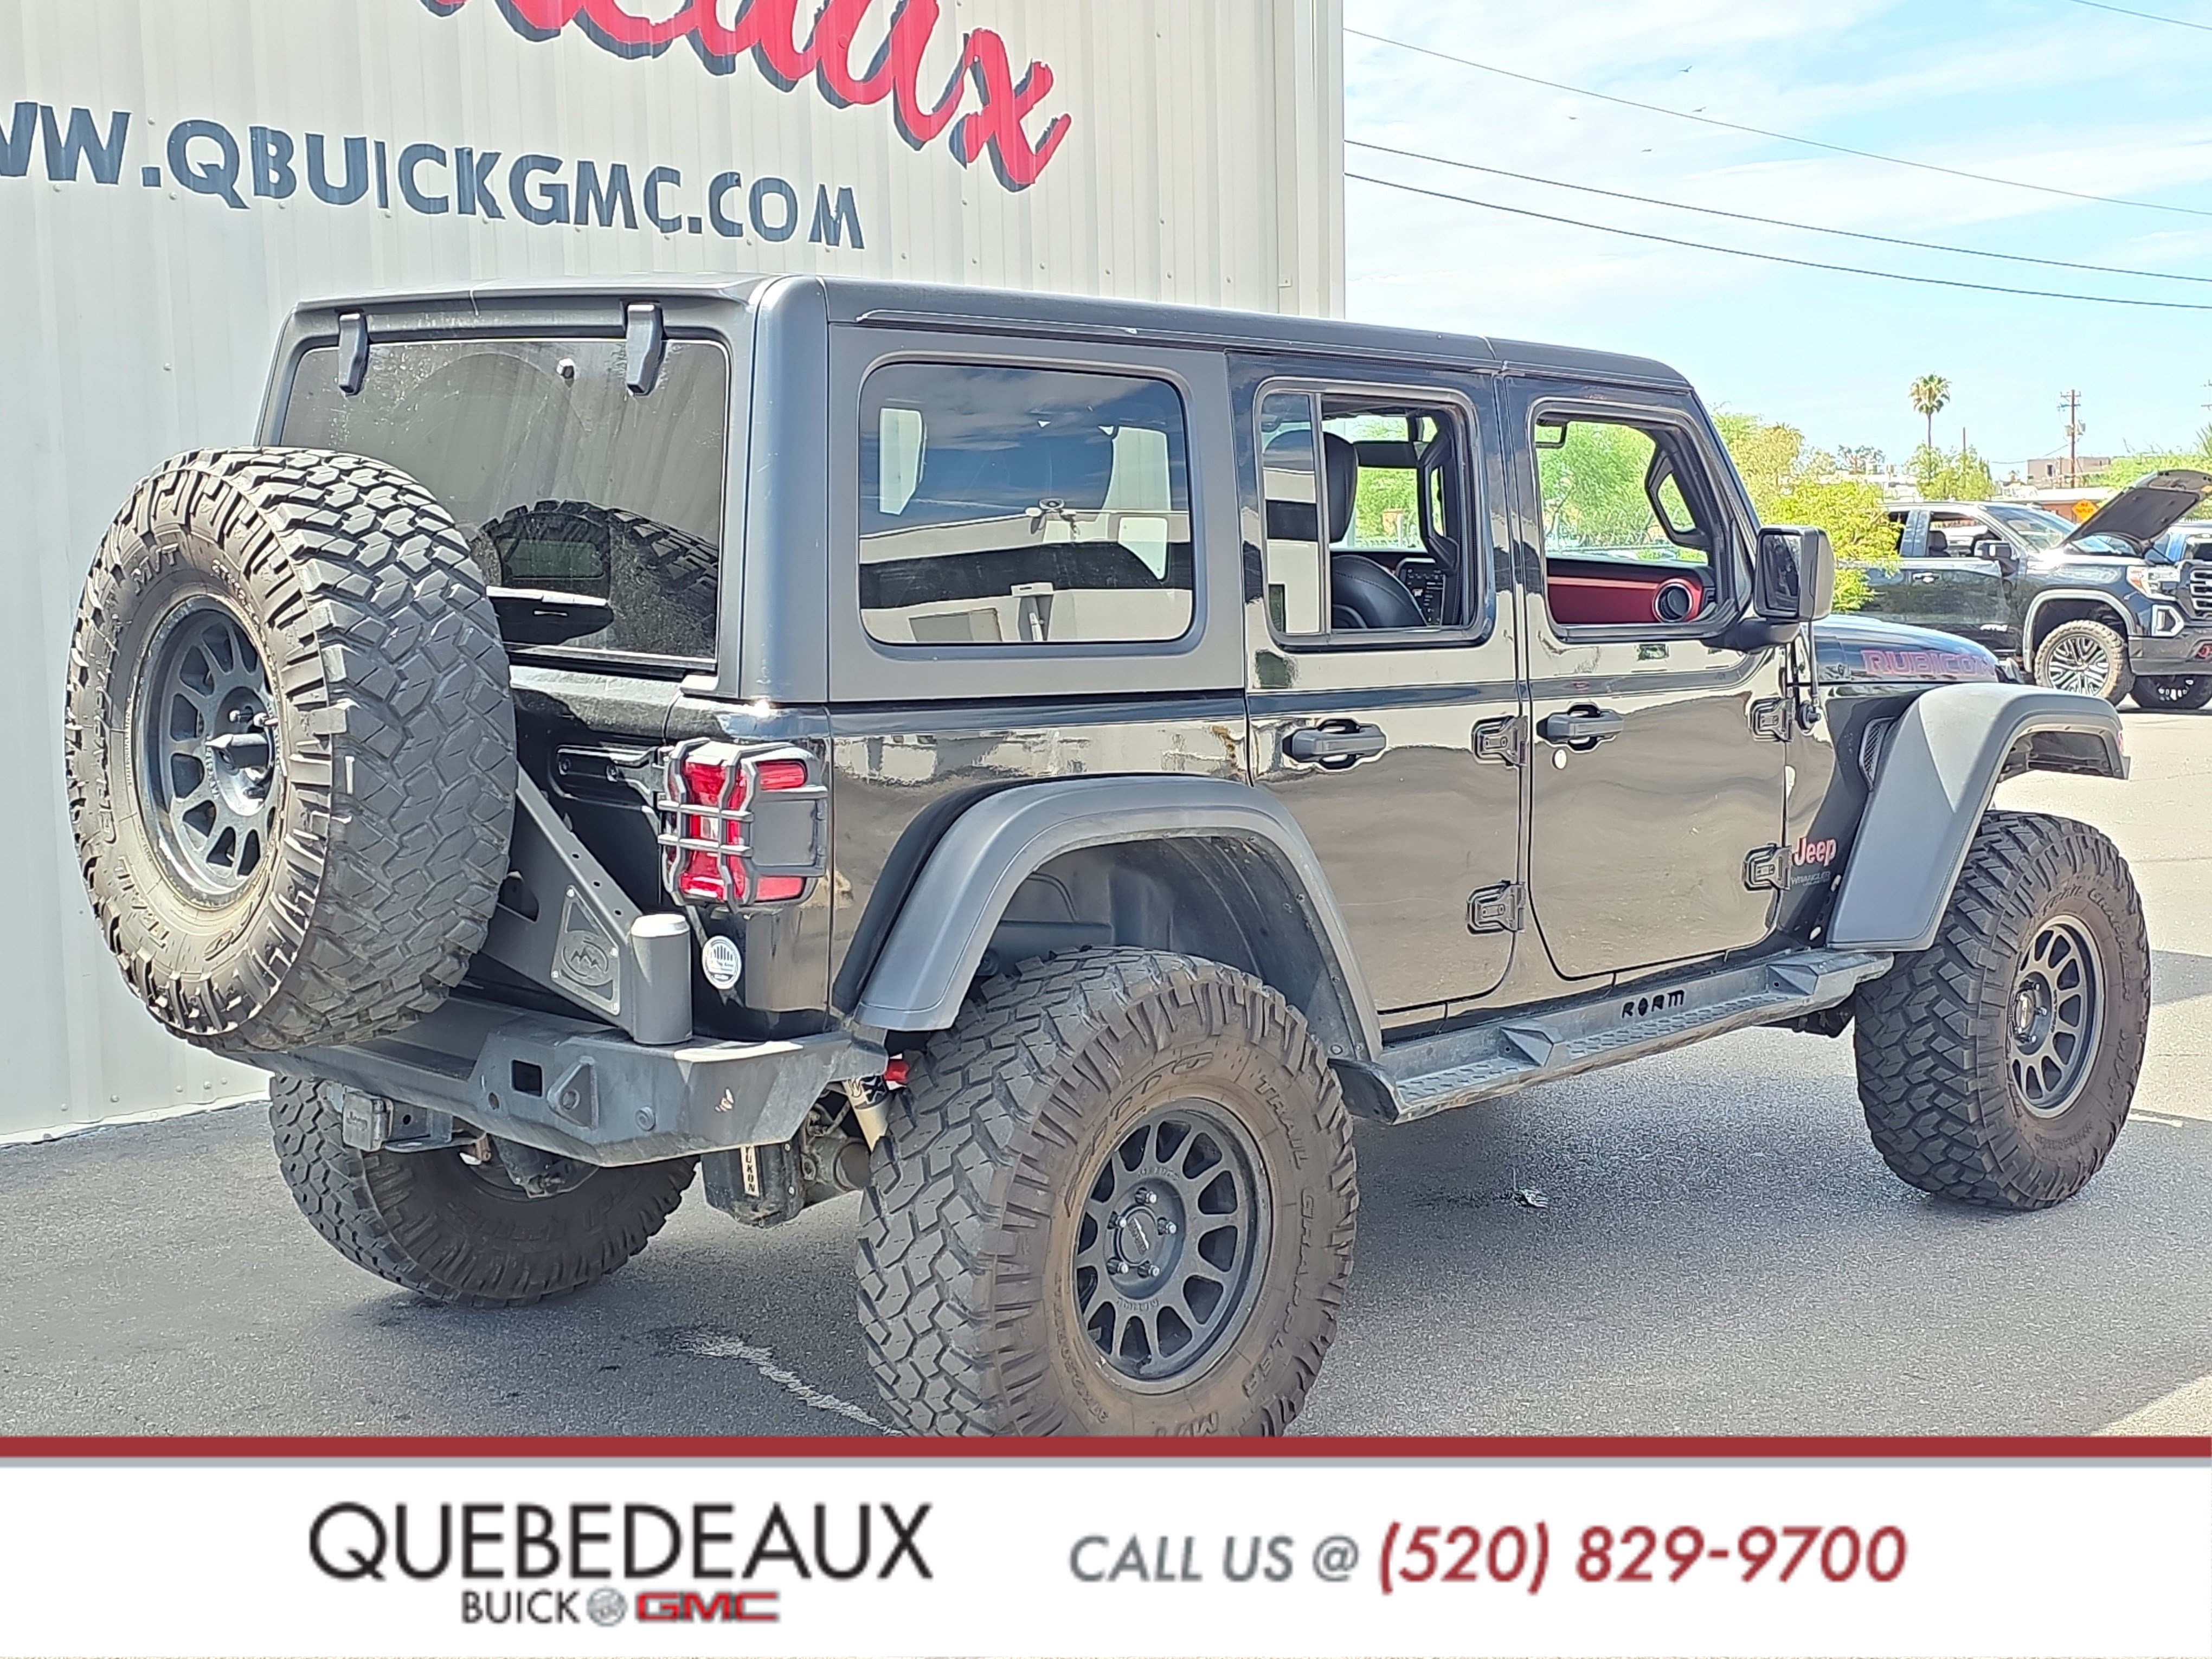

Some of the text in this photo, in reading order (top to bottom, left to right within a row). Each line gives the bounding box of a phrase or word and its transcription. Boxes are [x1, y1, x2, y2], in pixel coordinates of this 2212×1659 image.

[1861, 650, 1996, 676] RUBICON
[1791, 837, 1837, 867] Jeep
[1621, 989, 1685, 1019] ROAM
[745, 1146, 755, 1193] YUKON
[1242, 1075, 1315, 1400] TRAIL GRAPPLER
